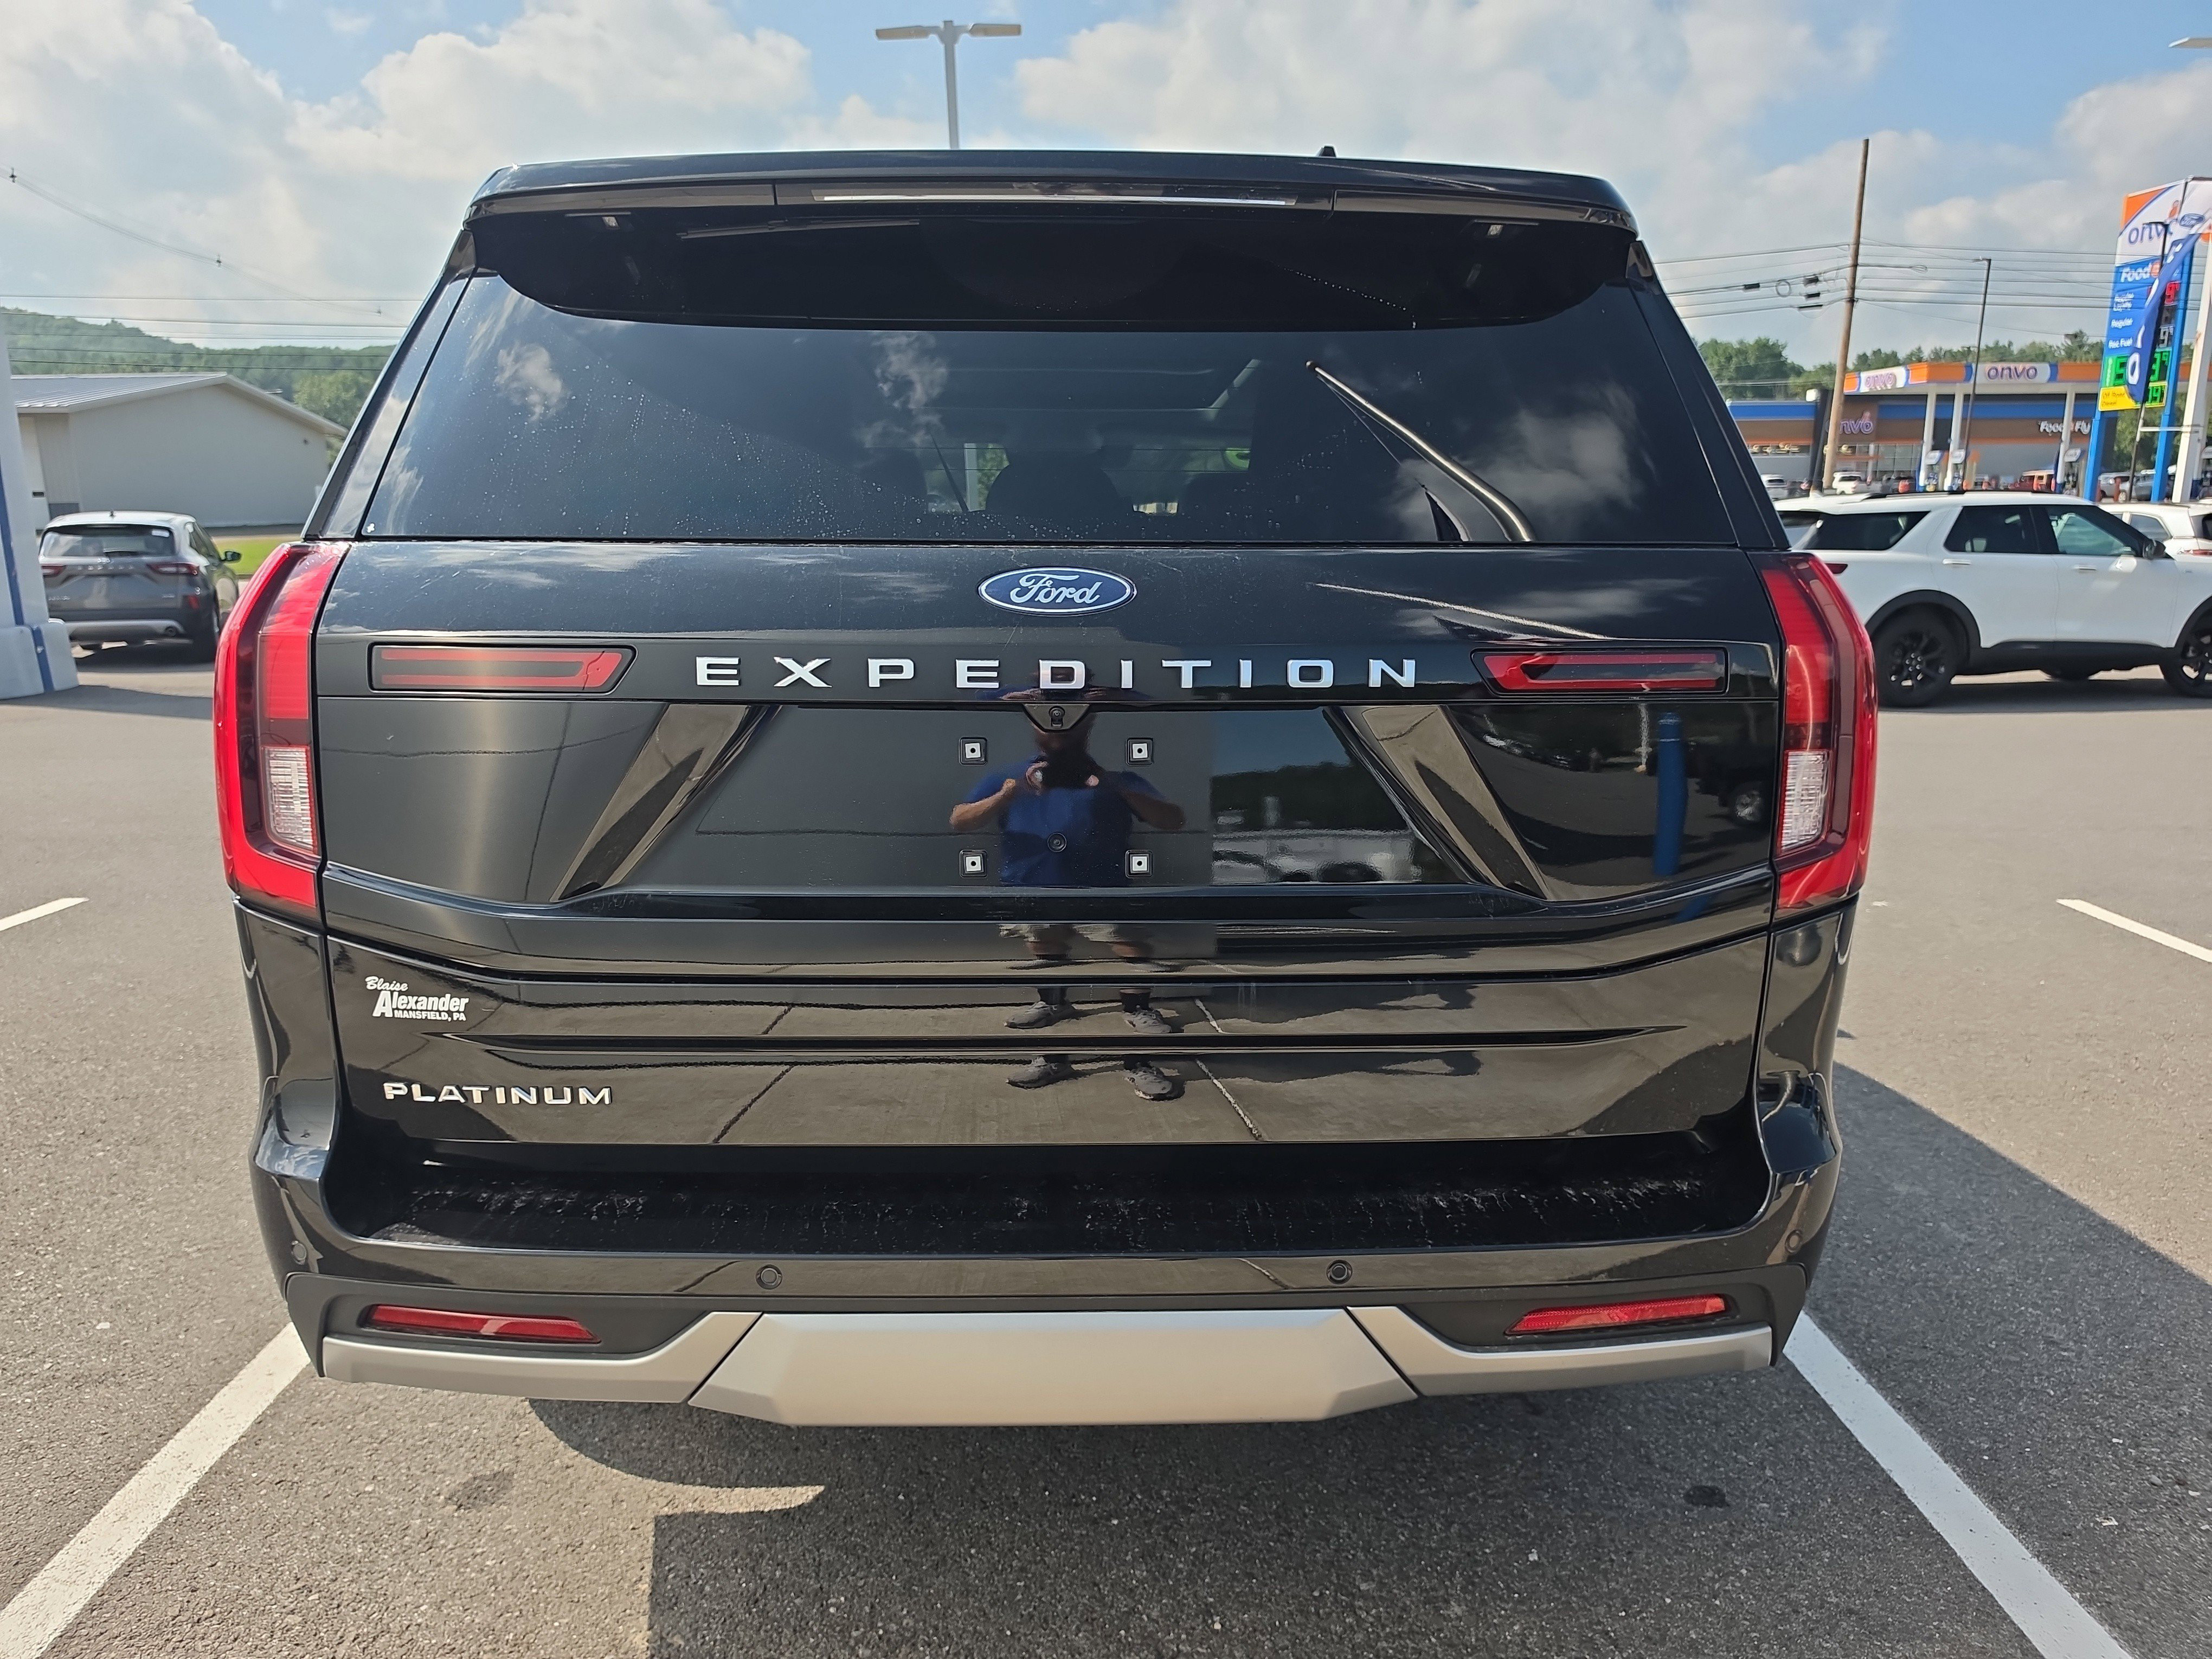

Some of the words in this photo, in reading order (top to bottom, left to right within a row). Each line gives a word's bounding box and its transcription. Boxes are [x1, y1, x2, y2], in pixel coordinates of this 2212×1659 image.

[2120, 263, 2151, 282] Food
[1864, 371, 1895, 388] onvo
[1986, 364, 2038, 381] onvo
[1009, 573, 1102, 604] Ford
[696, 656, 1416, 689] EXPEDITION
[365, 976, 408, 991] Blaise
[372, 990, 469, 1017] Alexander
[394, 1009, 451, 1022] MANSFIELD,
[453, 1012, 466, 1021] PA
[383, 1082, 612, 1105] PLATINUM
